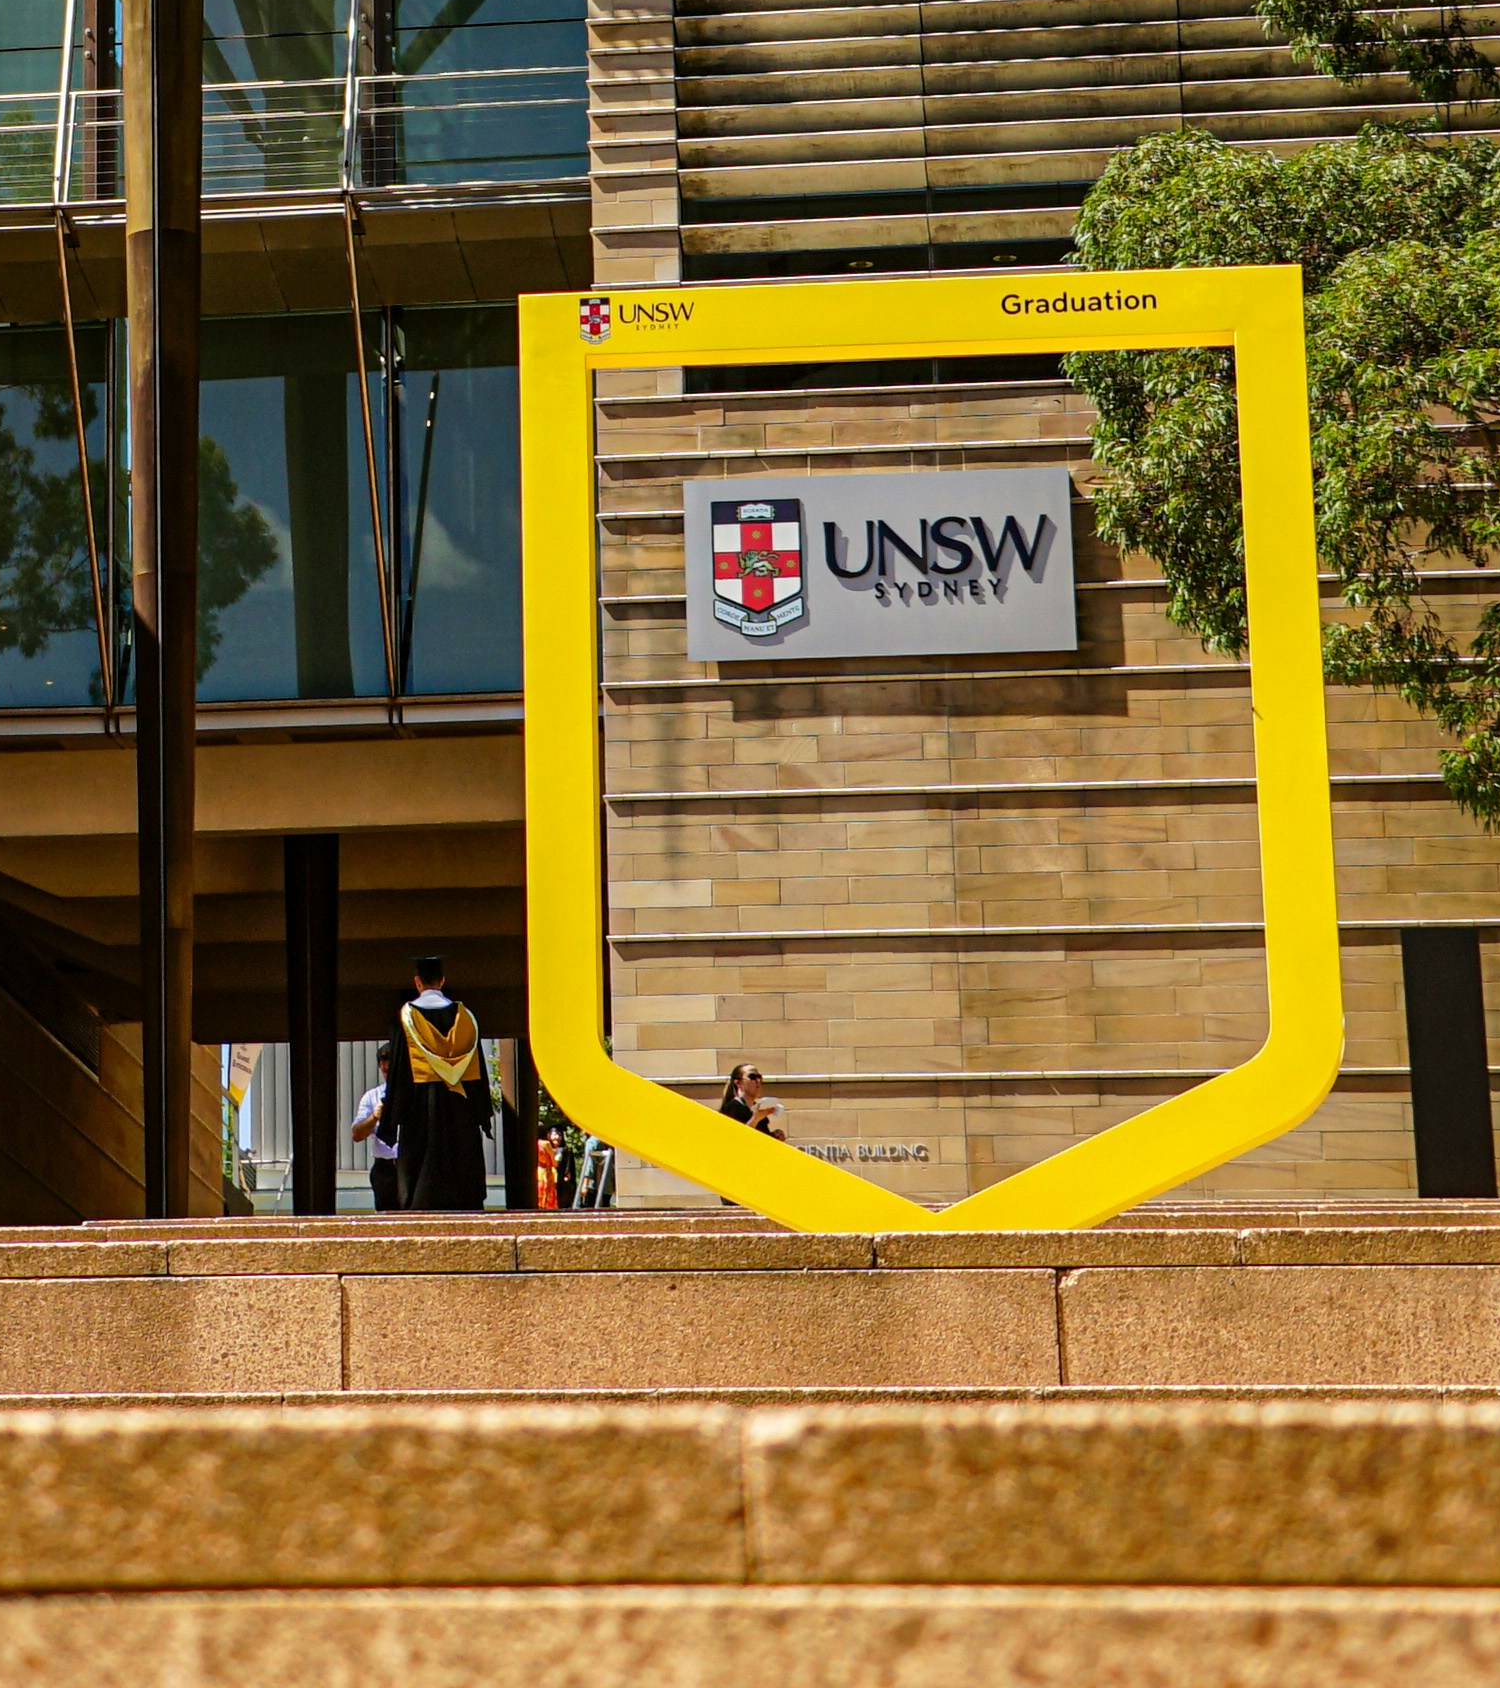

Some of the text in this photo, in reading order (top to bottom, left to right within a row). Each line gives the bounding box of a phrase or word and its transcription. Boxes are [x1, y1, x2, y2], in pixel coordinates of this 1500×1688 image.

[619, 302, 695, 324] UNSW
[1001, 289, 1157, 315] Graduation
[823, 514, 1047, 578] UNSW
[874, 578, 1001, 599] SYDNEY
[797, 1143, 929, 1159] IENTIA BUILDING
